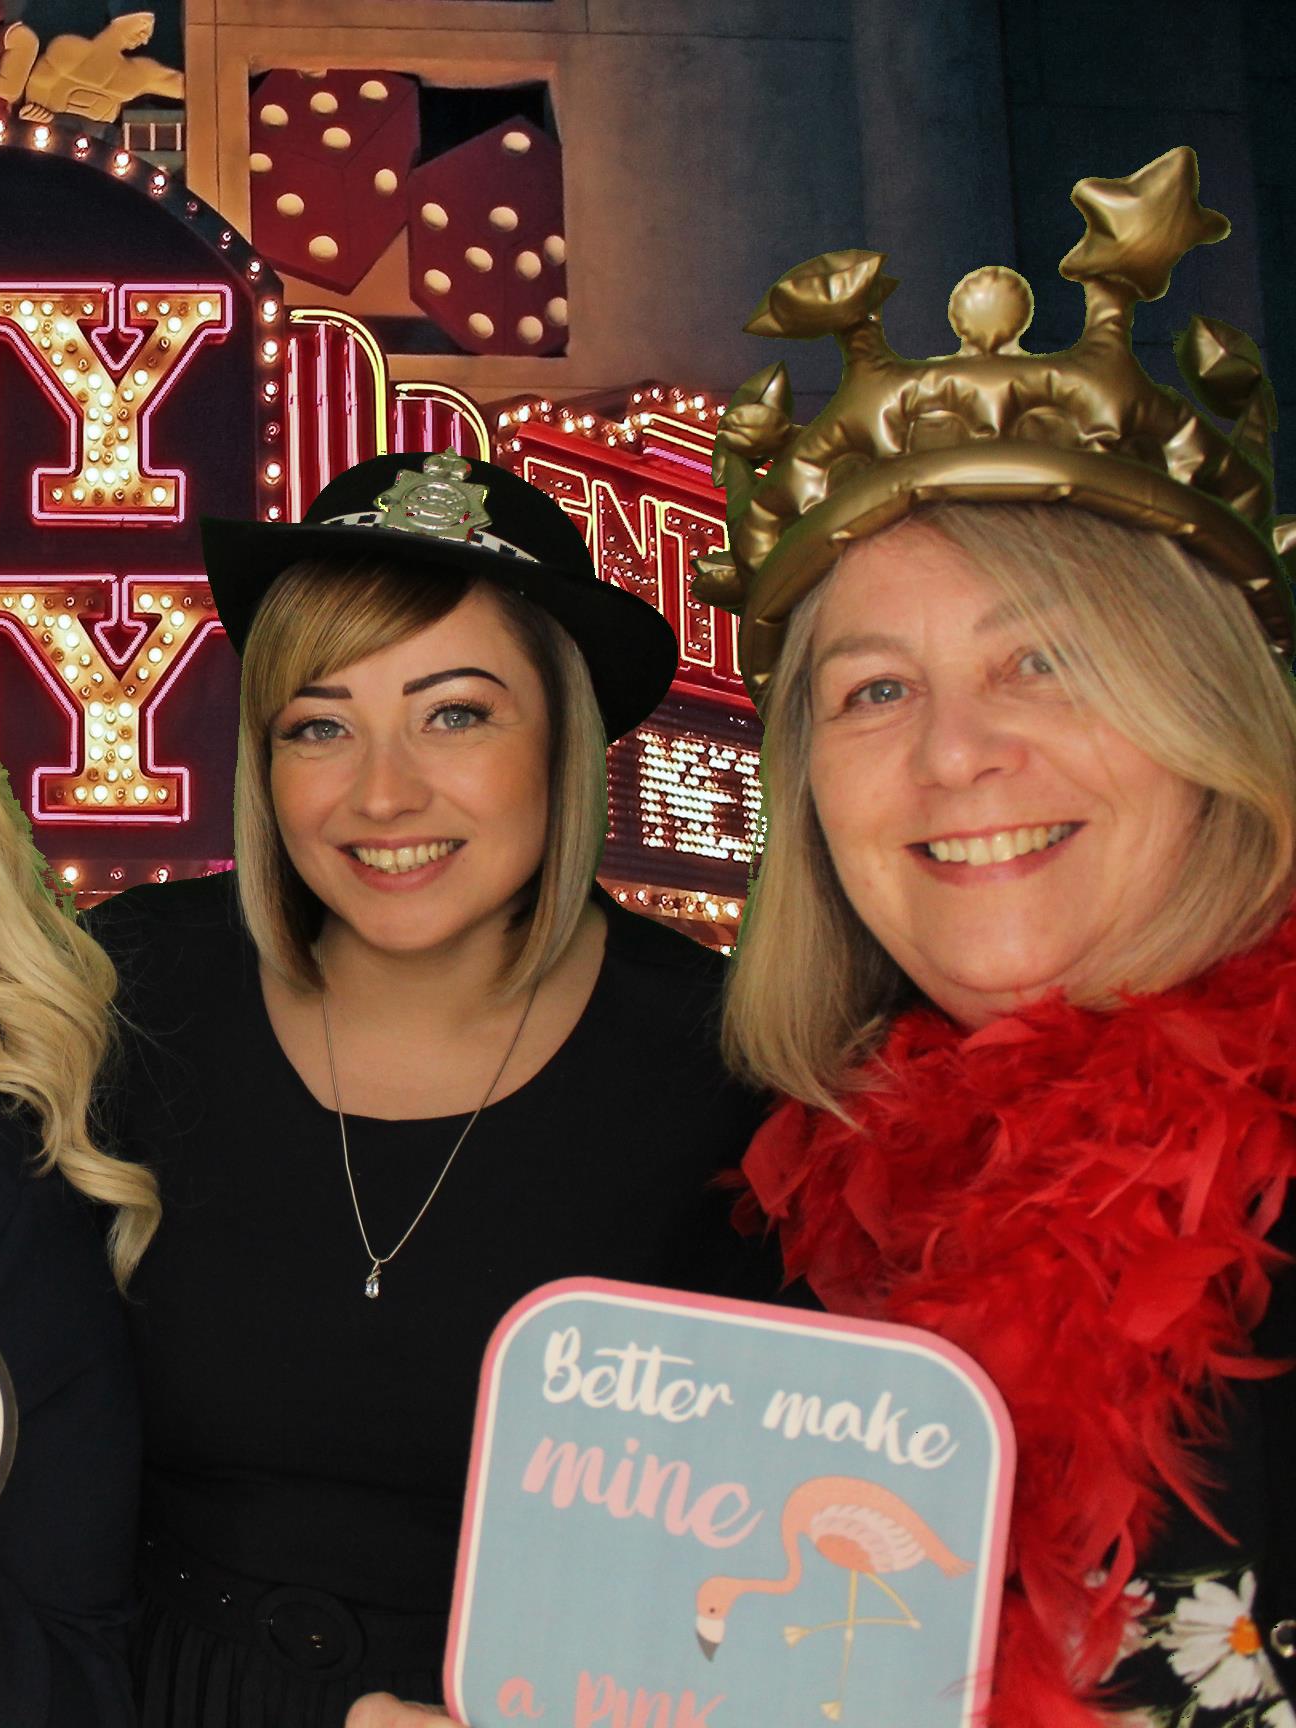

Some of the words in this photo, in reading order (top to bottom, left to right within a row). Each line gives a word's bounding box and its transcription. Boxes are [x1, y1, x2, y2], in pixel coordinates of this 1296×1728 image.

[542, 1326, 734, 1423] Better
[761, 1391, 959, 1469] make
[521, 1436, 764, 1548] mine
[497, 1675, 545, 1720] a
